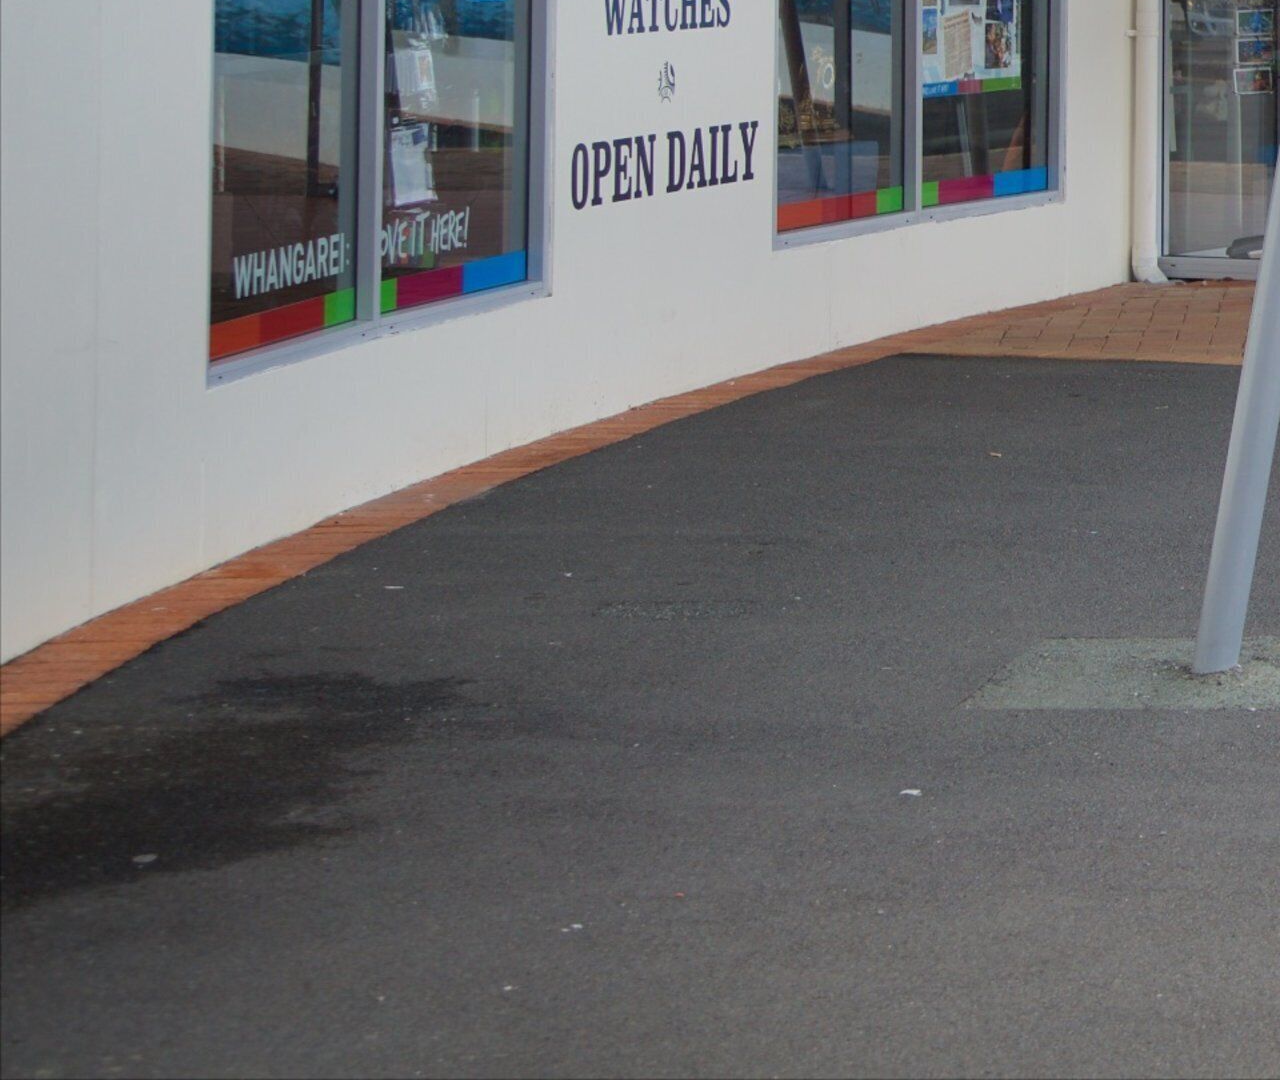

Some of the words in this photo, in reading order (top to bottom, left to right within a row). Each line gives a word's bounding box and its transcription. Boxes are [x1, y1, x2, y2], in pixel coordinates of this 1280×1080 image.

[571, 133, 657, 210] OPEN
[666, 120, 759, 194] DAILY
[233, 232, 350, 300] WHANGAREI:
[410, 210, 431, 257] IT
[431, 206, 470, 255] HERE!
